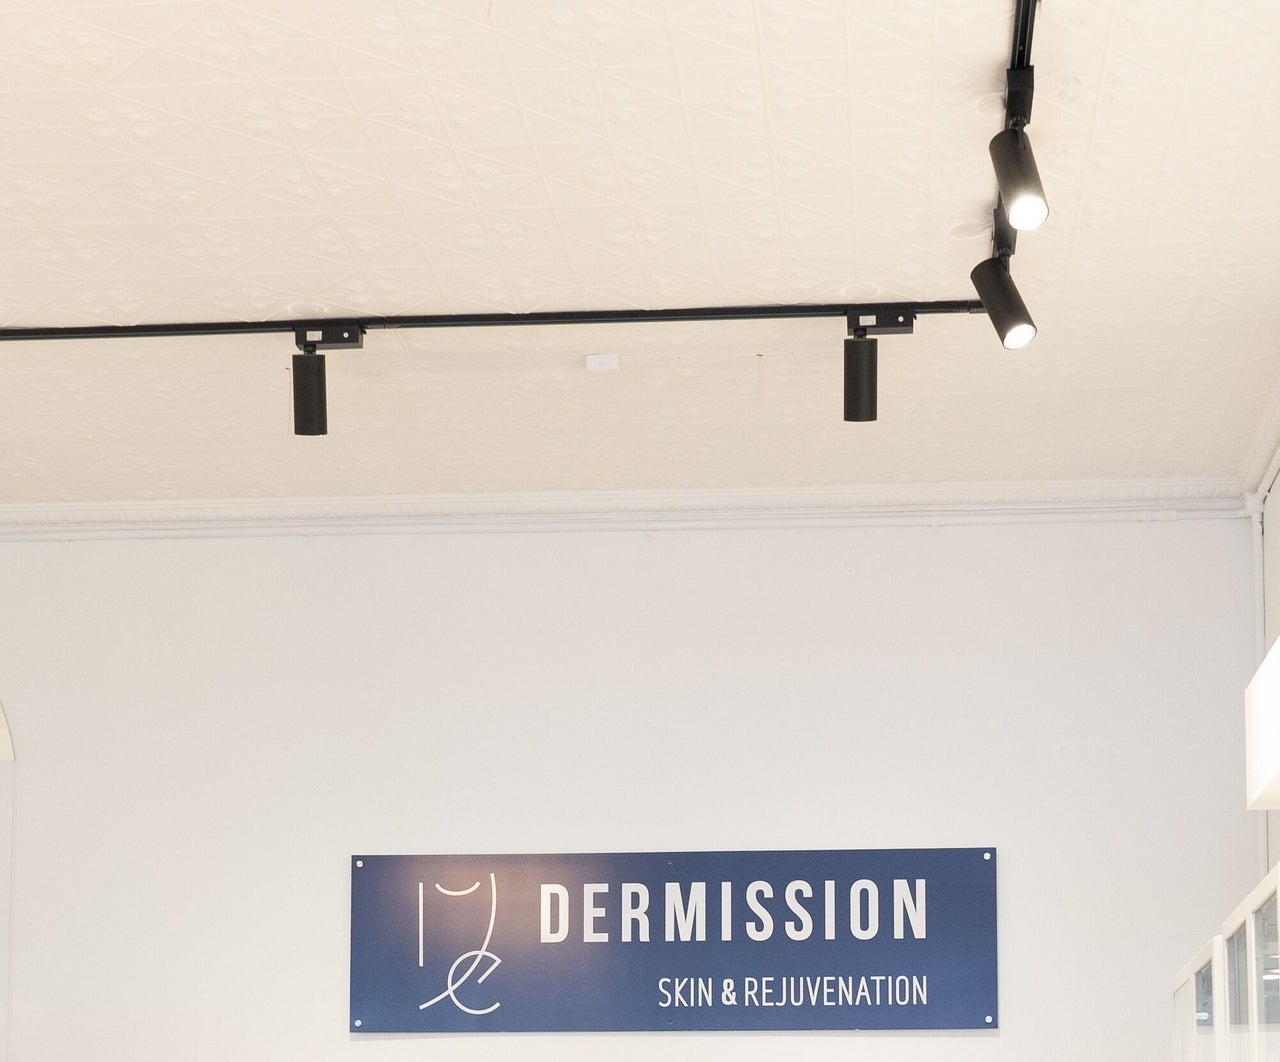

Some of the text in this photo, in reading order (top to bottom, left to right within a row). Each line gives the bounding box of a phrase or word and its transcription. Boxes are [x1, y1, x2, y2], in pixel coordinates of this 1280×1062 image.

[540, 879, 927, 943] DERMISSION
[658, 975, 928, 1008] SKIN & REJUVENATION
